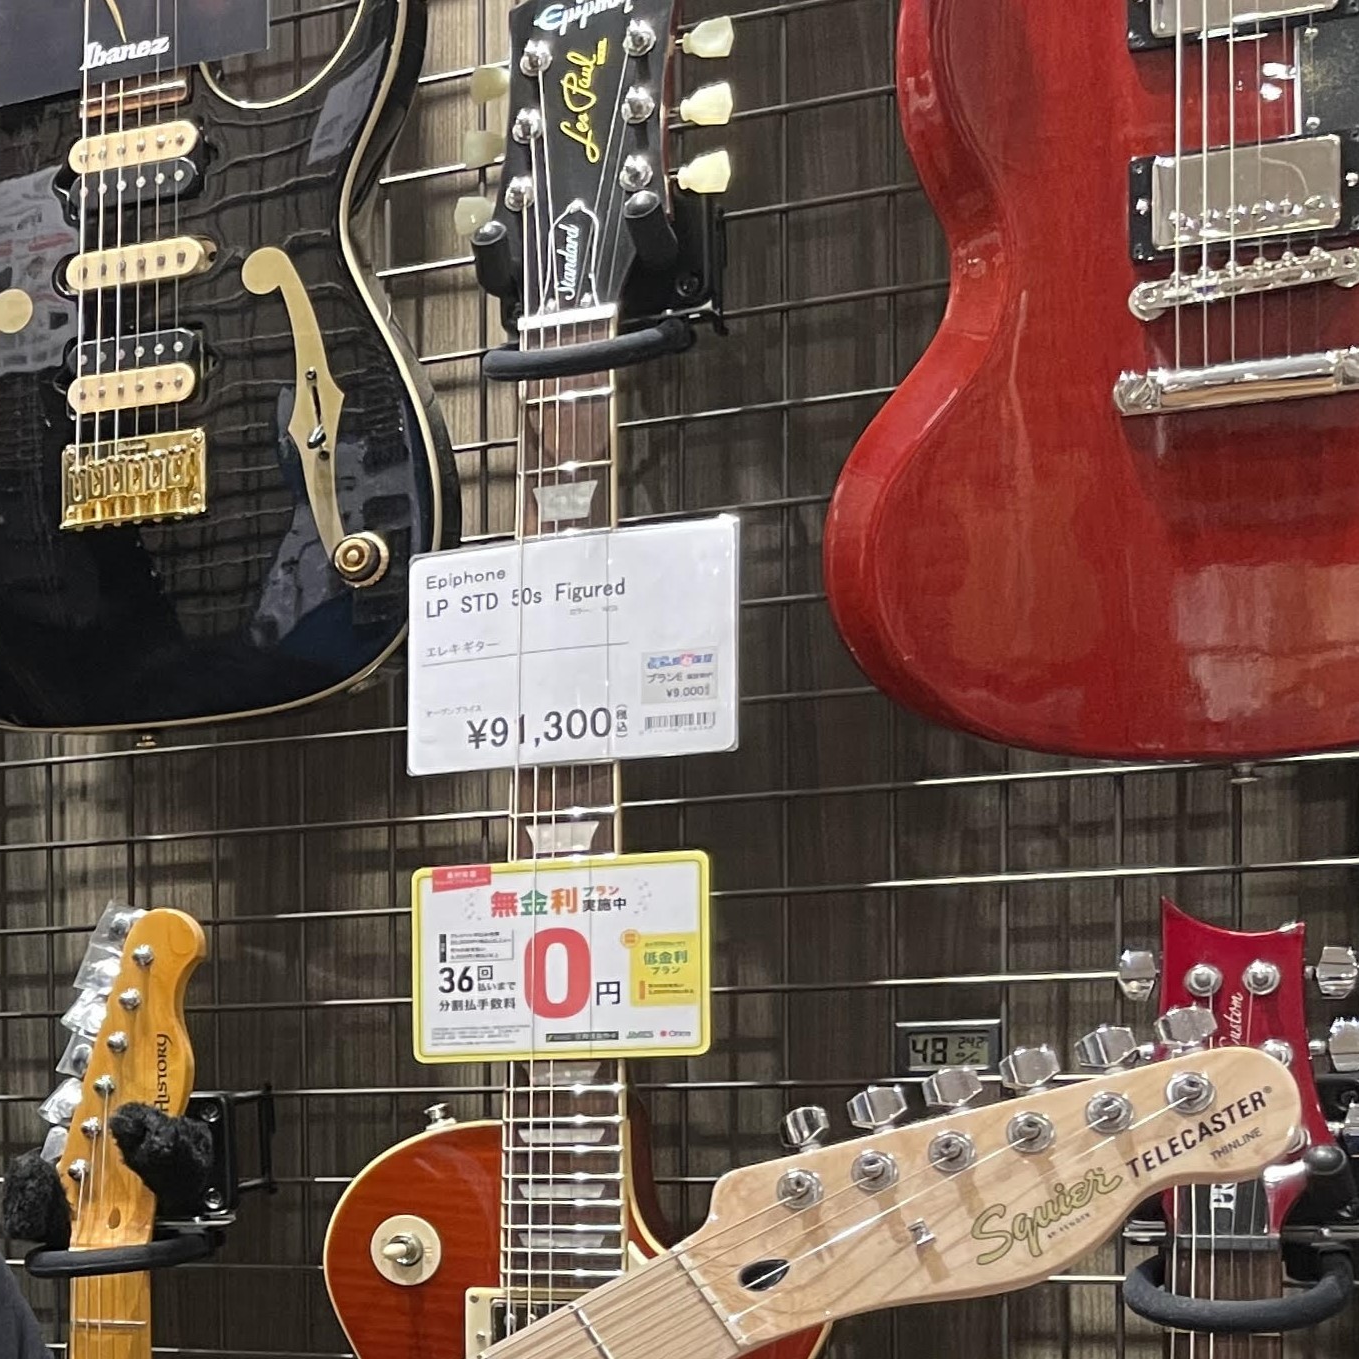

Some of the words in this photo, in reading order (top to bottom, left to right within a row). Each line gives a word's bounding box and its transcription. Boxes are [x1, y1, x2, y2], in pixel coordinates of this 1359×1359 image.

[79, 36, 170, 71] Ibanez
[559, 50, 598, 111] Paul
[559, 113, 601, 163] Les
[558, 223, 580, 300] Standard
[426, 569, 506, 591] Epiphone
[426, 599, 449, 619] LP
[460, 592, 499, 614] STD
[511, 587, 542, 607] 50s
[555, 577, 626, 603] Figured
[426, 640, 500, 658] エレキギター
[466, 707, 613, 749] ¥91,300
[490, 887, 579, 918] 無金利
[582, 897, 627, 913] 実施中
[583, 885, 620, 897] プラン
[438, 965, 475, 994] 36
[477, 965, 493, 981] 回
[523, 927, 592, 1020] 0
[439, 997, 516, 1012] 分割払手数料
[596, 981, 621, 1006] 円
[911, 1037, 948, 1065] 48
[1126, 1090, 1268, 1179] TELECASTER
[1209, 1127, 1264, 1162] THINLINE
[971, 1168, 1124, 1266] Squier
